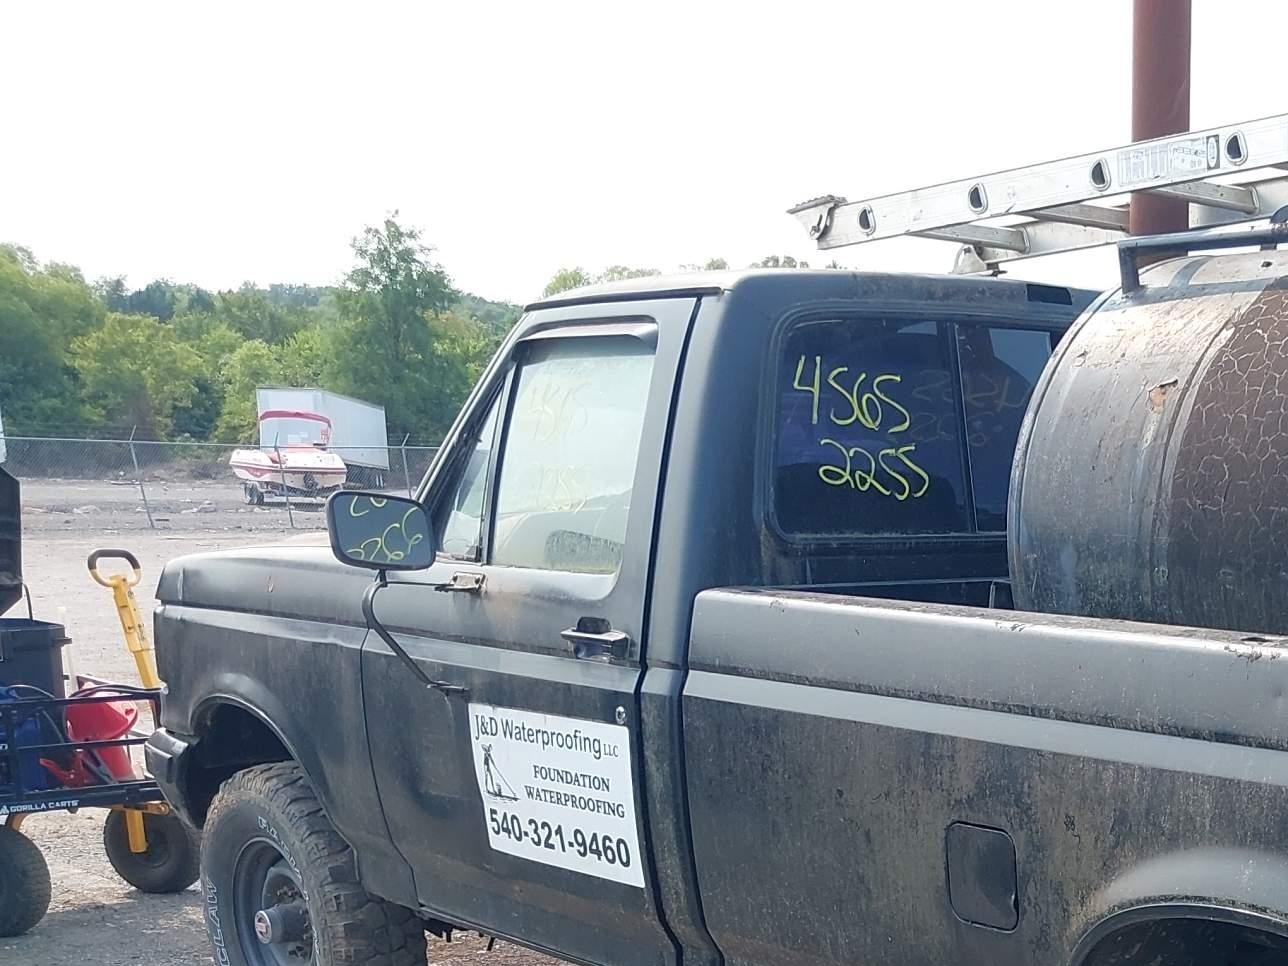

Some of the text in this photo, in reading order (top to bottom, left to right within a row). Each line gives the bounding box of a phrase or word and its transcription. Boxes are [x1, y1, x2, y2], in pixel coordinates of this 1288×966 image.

[793, 355, 911, 433] 4565
[818, 438, 929, 501] 2255
[474, 714, 619, 760] J&D Waterproofing LLC
[533, 764, 611, 792] FOUNDATION
[10, 800, 80, 812] GORILLA CARTS
[524, 785, 626, 818] WATERPROOFING
[489, 808, 631, 868] 540-321-9460
